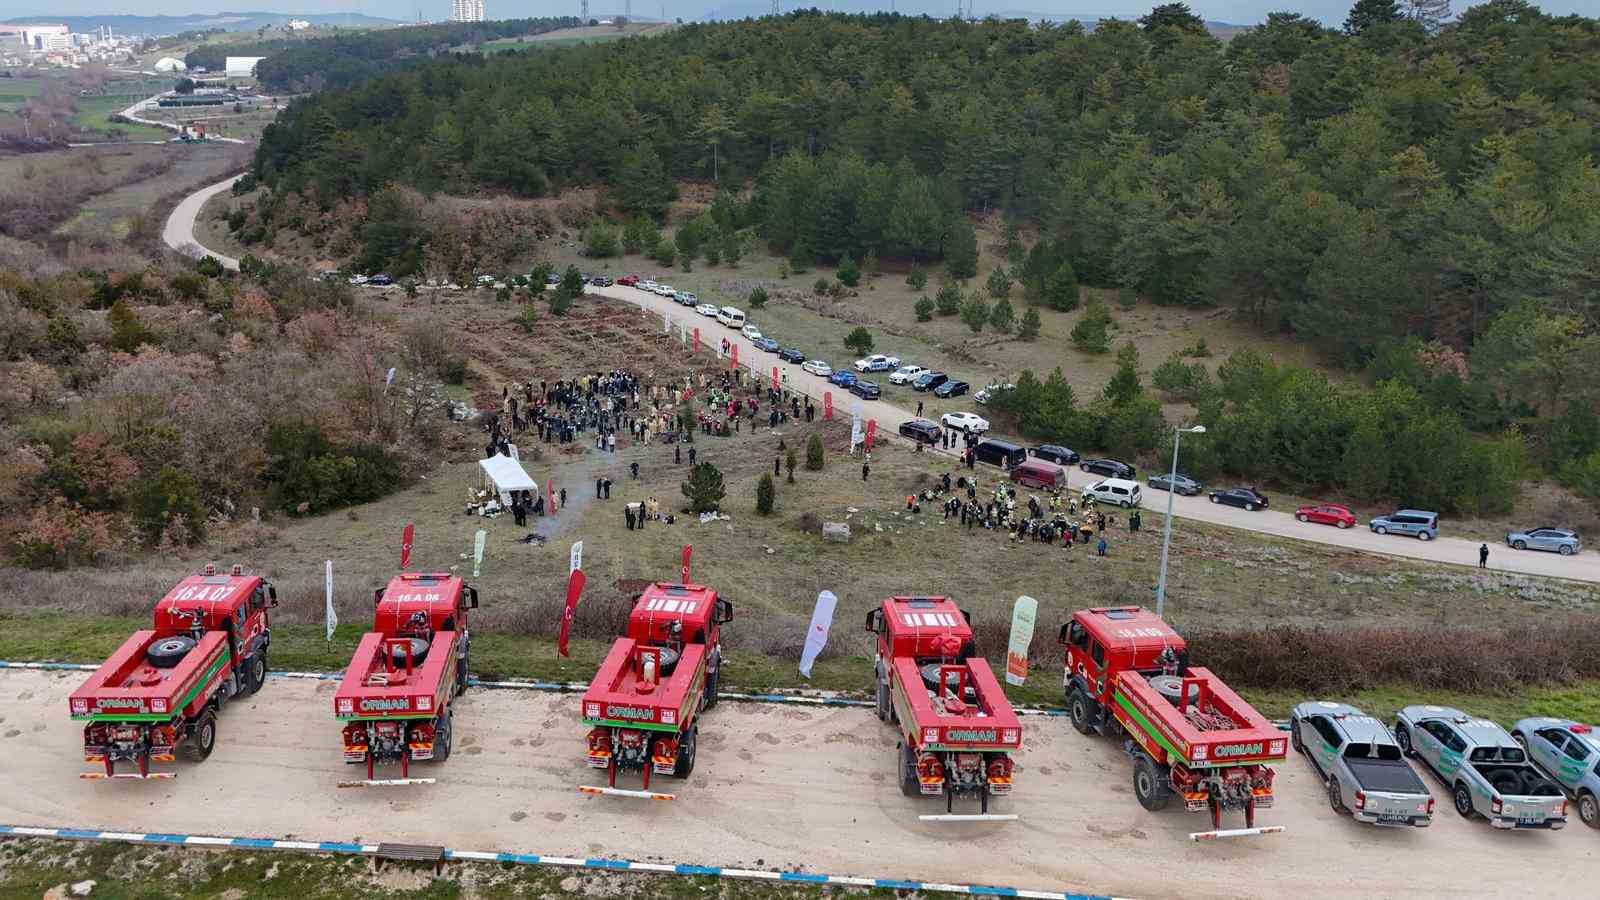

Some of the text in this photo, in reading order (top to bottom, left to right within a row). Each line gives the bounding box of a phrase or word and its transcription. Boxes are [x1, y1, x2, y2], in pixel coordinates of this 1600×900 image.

[96, 698, 144, 708] ORMAN
[360, 698, 409, 711] ORMAN
[607, 706, 654, 720] ORMAN
[946, 730, 996, 742] ORMAN
[1215, 743, 1263, 757] ORMAN
